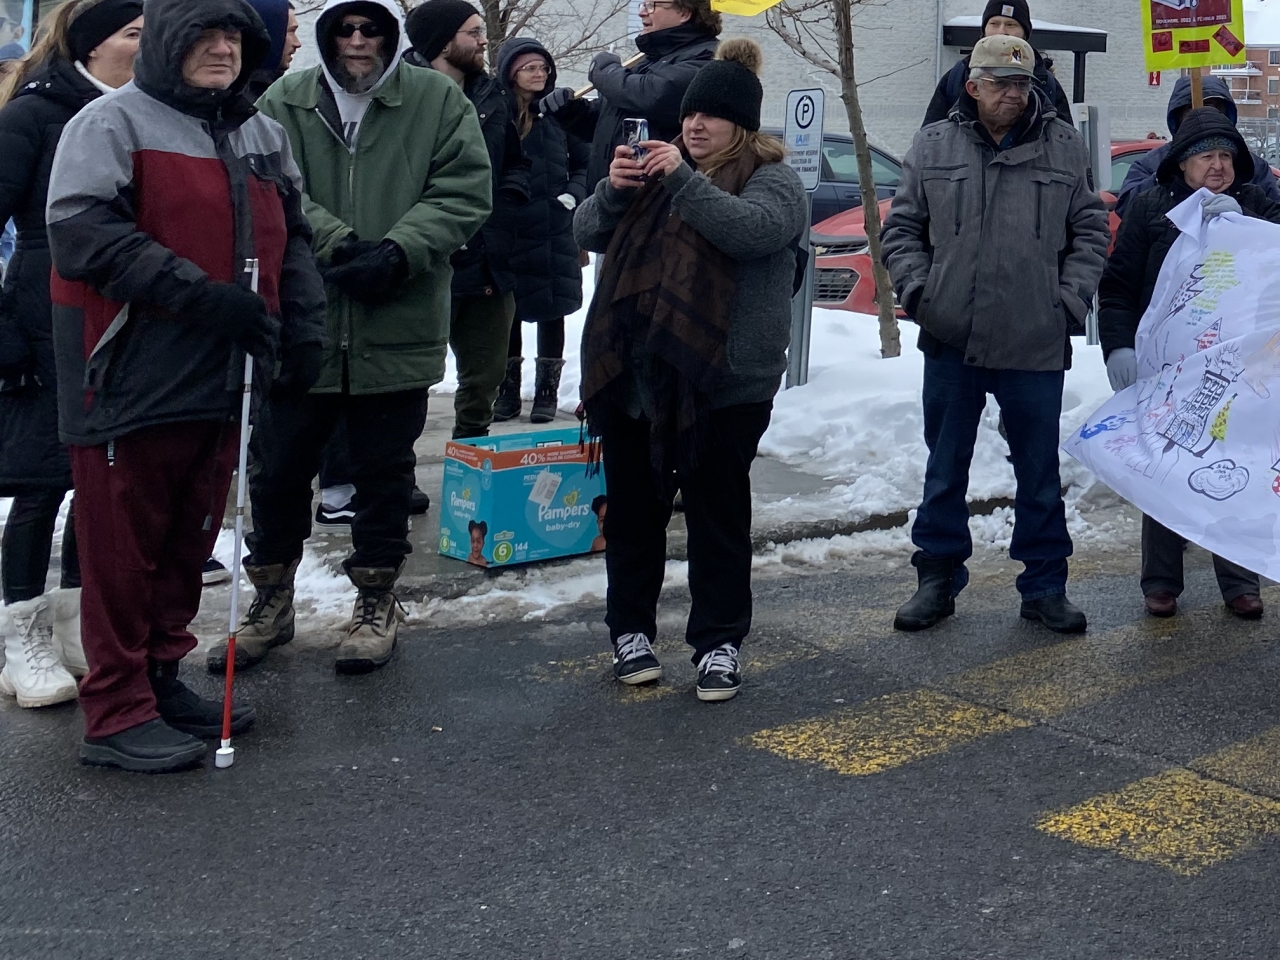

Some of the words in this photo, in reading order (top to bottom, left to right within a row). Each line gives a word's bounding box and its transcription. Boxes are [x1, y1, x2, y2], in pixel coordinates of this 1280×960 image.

[520, 452, 546, 465] 40%
[450, 491, 475, 511] Pampers
[538, 503, 589, 522] Pampers
[546, 521, 580, 531] baby-dry
[498, 544, 507, 556] 6
[514, 542, 528, 551] 144
